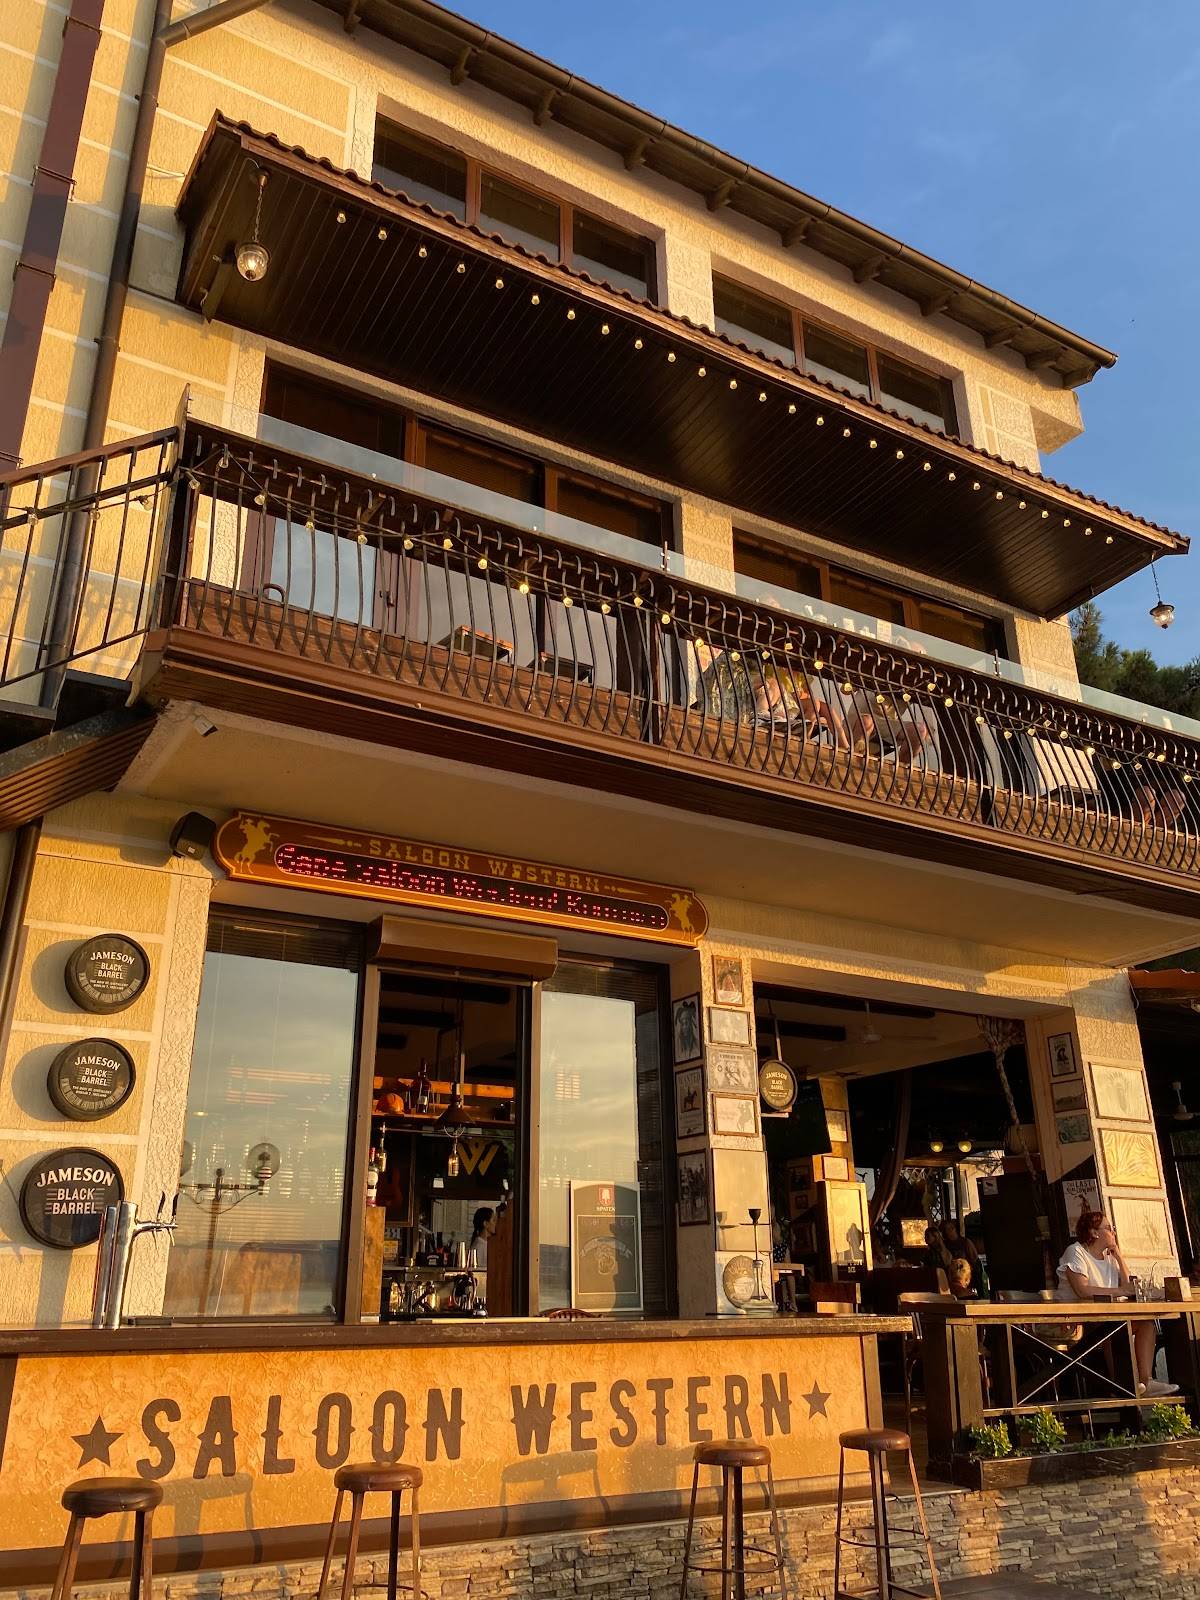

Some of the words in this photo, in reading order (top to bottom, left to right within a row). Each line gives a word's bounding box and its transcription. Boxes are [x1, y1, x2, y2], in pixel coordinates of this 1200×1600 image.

[369, 839, 470, 871] SALOON
[487, 859, 600, 893] WESTERN
[90, 951, 135, 965] JAMESON
[100, 962, 123, 971] BLACK
[97, 970, 124, 980] BARREL
[74, 1055, 121, 1071] JAMESON
[84, 1067, 108, 1078] BLACK
[80, 1075, 108, 1086] BARREL
[36, 1167, 116, 1188] JAMESON
[57, 1187, 96, 1201] BLACK
[52, 1202, 97, 1215] BARREL
[136, 1387, 466, 1480] SALOON
[509, 1371, 793, 1456] WESTERN
